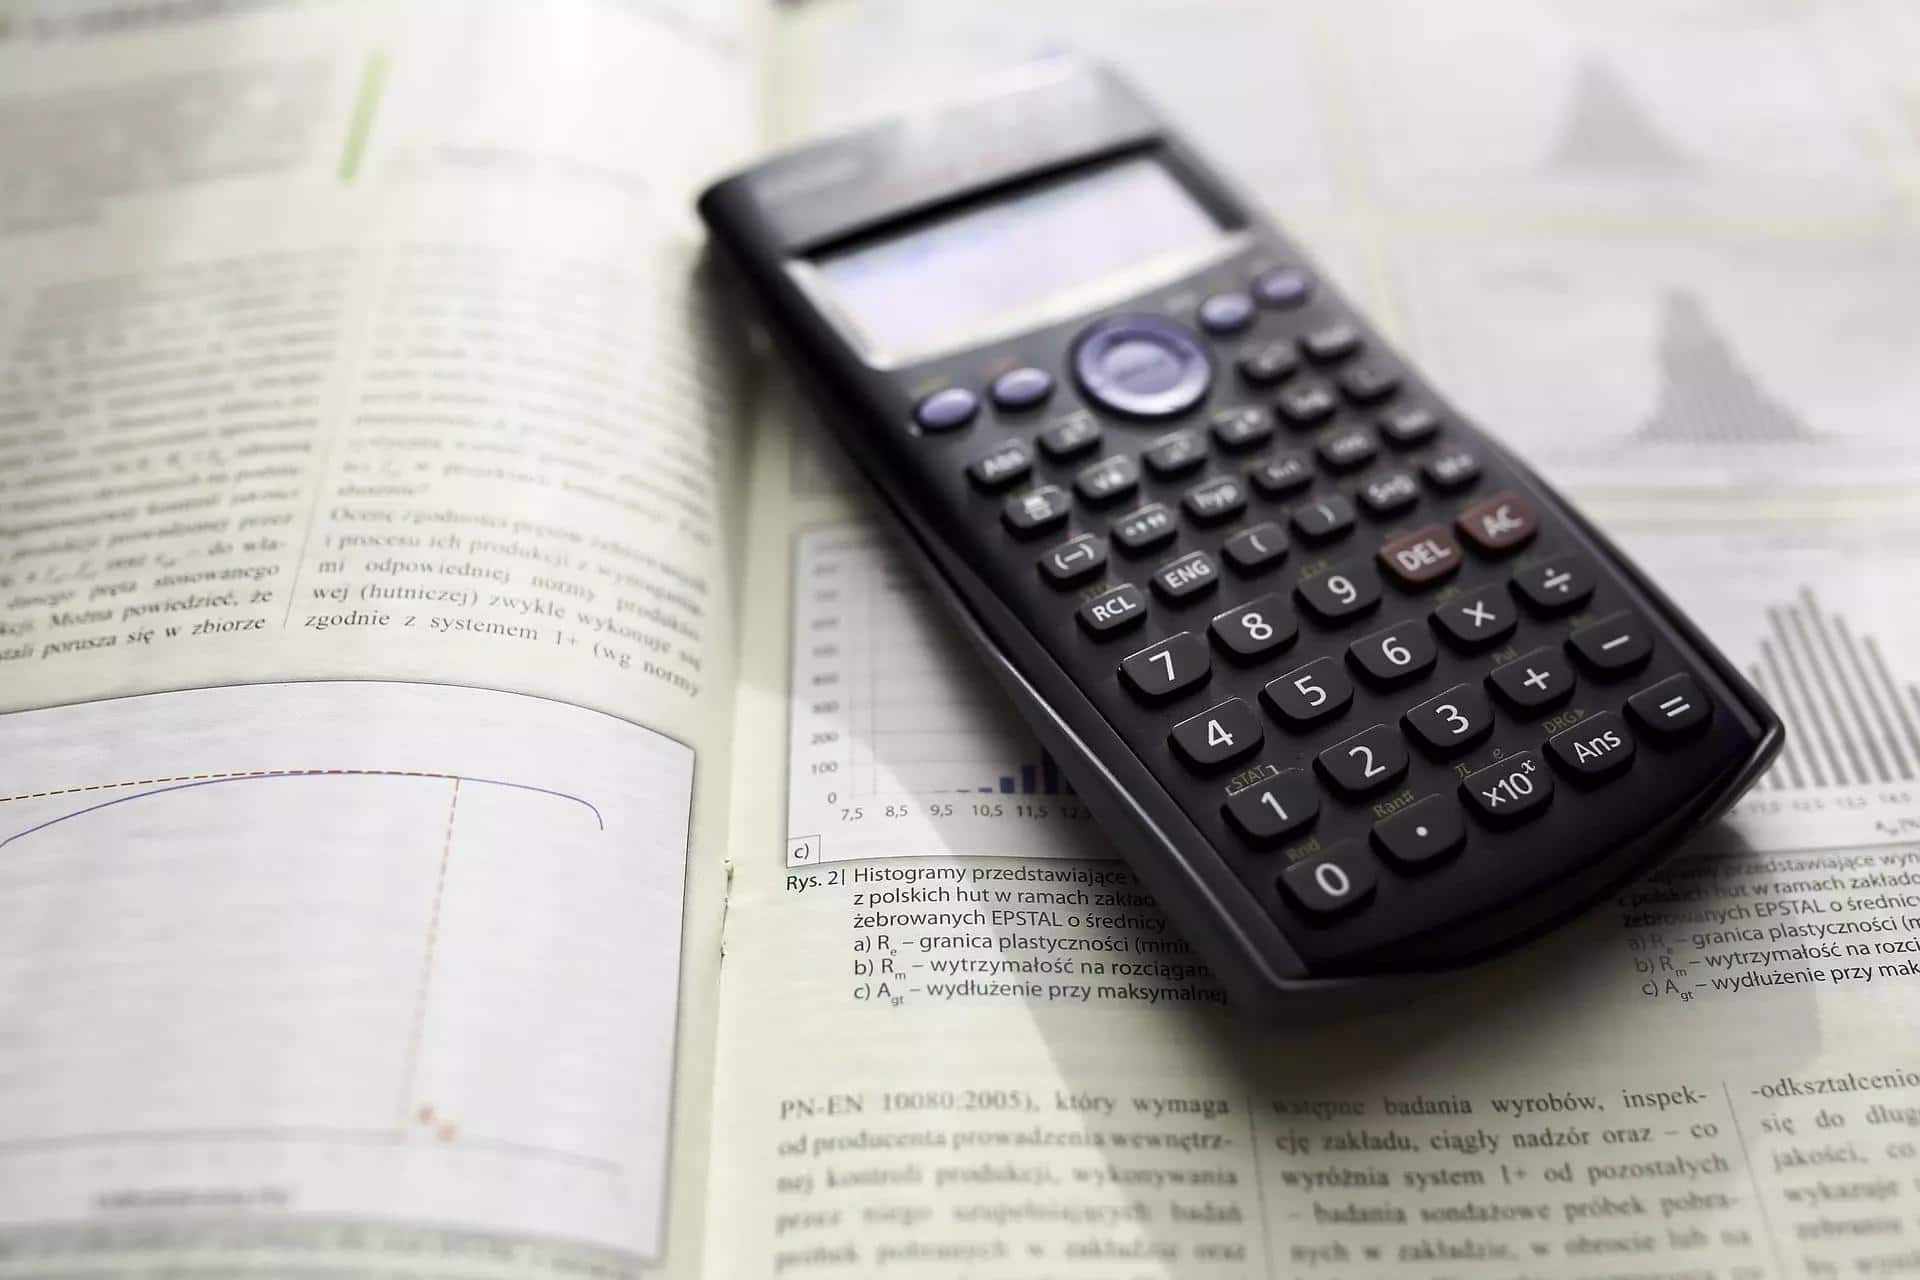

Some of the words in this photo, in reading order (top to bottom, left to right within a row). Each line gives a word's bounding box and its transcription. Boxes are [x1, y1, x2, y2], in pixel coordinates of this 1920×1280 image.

[1482, 504, 1524, 538] AC
[430, 532, 461, 550] ich
[1397, 539, 1452, 572] DEL
[319, 559, 345, 574] mi
[365, 557, 511, 585] odpowiedniej
[1164, 558, 1211, 589] ENG
[1327, 575, 1357, 604] 9
[313, 586, 349, 604] wej
[360, 583, 479, 607] (hutniczej)
[488, 592, 566, 619] zwykle
[577, 611, 672, 653] wykonuje
[1091, 594, 1137, 622] RCL
[128, 626, 155, 645] się
[166, 626, 181, 638] w
[192, 617, 266, 636] zbiorze
[1241, 613, 1273, 641] 8
[305, 609, 390, 631] zgodnie
[404, 615, 417, 627] z
[430, 615, 538, 641] systemem
[594, 642, 632, 669] (wg
[643, 660, 700, 699] normy
[1148, 650, 1176, 681] 7
[1381, 636, 1412, 666] 6
[1293, 675, 1327, 706] 5
[1207, 719, 1233, 747] 4
[1435, 704, 1470, 734] 3
[1572, 729, 1621, 764] Ans
[811, 761, 838, 775] 100
[1348, 745, 1386, 778] 2
[826, 792, 837, 805] 0
[841, 807, 863, 821] 7,5
[885, 804, 908, 819] 8,5
[930, 804, 953, 818] 9,5
[972, 804, 1003, 819] 10,5
[1016, 804, 1048, 819] 11,5
[1261, 791, 1288, 820] 1
[794, 843, 810, 861] c)
[786, 875, 822, 893] Rys.
[854, 867, 967, 884] Histogramy
[973, 866, 1126, 887] przedstawiające
[1315, 862, 1350, 897] 0
[1752, 883, 1768, 897] w
[1774, 875, 1845, 894] ramach
[853, 893, 864, 906] z
[870, 886, 950, 908] polskich
[956, 886, 989, 903] hut
[995, 891, 1012, 904] w
[1017, 889, 1089, 906] ramach
[1756, 900, 1825, 918] EPSTAL
[1830, 899, 1842, 913] o
[853, 909, 985, 928] żebrowanych
[992, 910, 1063, 928] EPSTAL
[1067, 915, 1080, 928] o
[1086, 911, 1167, 934] średnicy
[1692, 927, 1764, 949] granica
[1770, 916, 1897, 945] plastyczności
[854, 936, 871, 953] a)
[919, 933, 993, 952] granica
[999, 933, 1129, 954] plastyczności
[1636, 957, 1655, 974] b)
[1705, 945, 1841, 970] wytrzymałość
[1846, 942, 1871, 957] na
[854, 959, 874, 977] b)
[930, 957, 1074, 977] wytrzymałość
[1081, 961, 1105, 976] na
[1642, 981, 1659, 998] c)
[1711, 966, 1825, 993] wydłużenie
[1830, 965, 1872, 985] przy
[854, 983, 871, 1000] c)
[927, 979, 1042, 1000] wydłużenie
[1050, 984, 1092, 1001] przy
[1098, 979, 1228, 1006] maksymalnej
[781, 1092, 864, 1120] PN-EN
[1055, 1090, 1114, 1117] który
[1132, 1096, 1230, 1121] wymaga
[1384, 1096, 1472, 1117] badania
[1491, 1092, 1605, 1119] wyrobów,
[1621, 1085, 1708, 1112] inspek-
[1761, 1113, 1795, 1136] się
[1815, 1109, 1846, 1129] do
[778, 1133, 807, 1156] od
[813, 1128, 947, 1158] producenta
[952, 1126, 1105, 1151] prowadzenia
[1111, 1132, 1233, 1154] wewnętrz-
[1323, 1129, 1420, 1152] zakładu,
[1429, 1129, 1499, 1155] ciągły
[1512, 1126, 1591, 1149] nadzór
[1602, 1127, 1652, 1145] oraz
[1690, 1122, 1719, 1139] co
[1281, 1164, 1390, 1194] wyróżnia
[1403, 1169, 1485, 1193] system
[1543, 1162, 1574, 1183] od
[1587, 1153, 1730, 1187] pozostałych
